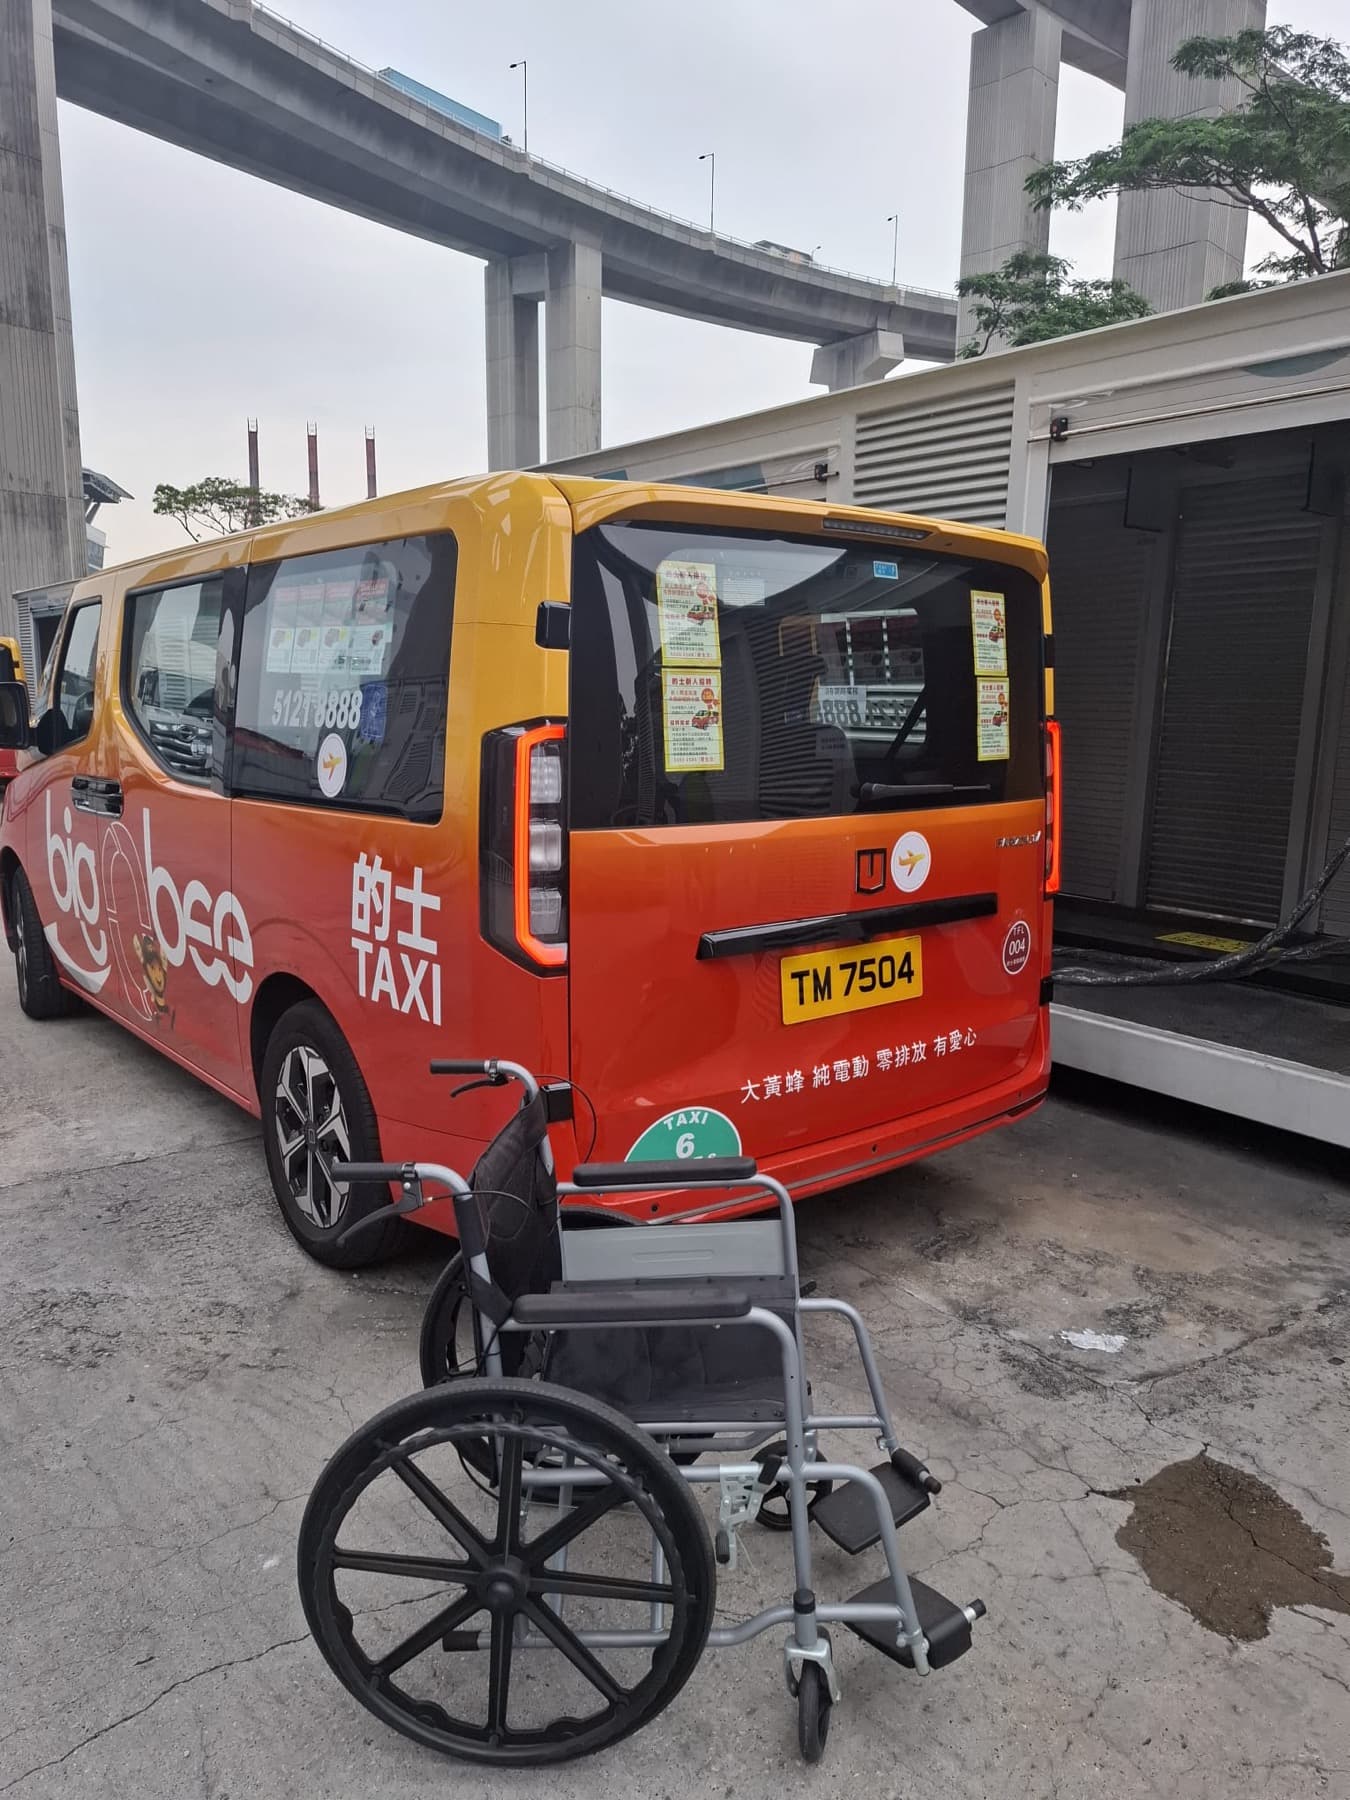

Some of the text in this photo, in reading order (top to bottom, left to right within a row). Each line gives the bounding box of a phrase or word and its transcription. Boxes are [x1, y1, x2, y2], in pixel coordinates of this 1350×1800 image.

[46, 790, 254, 1004] big bee
[352, 851, 441, 955] 的士
[790, 951, 915, 1006] TM 7504
[1008, 937, 1026, 956] 004
[351, 937, 441, 1026] TAXI
[740, 1026, 977, 1104] 大黃蜂 純電動 零排放 有愛心
[663, 1111, 708, 1131] TAXI
[676, 1132, 695, 1159] 6
